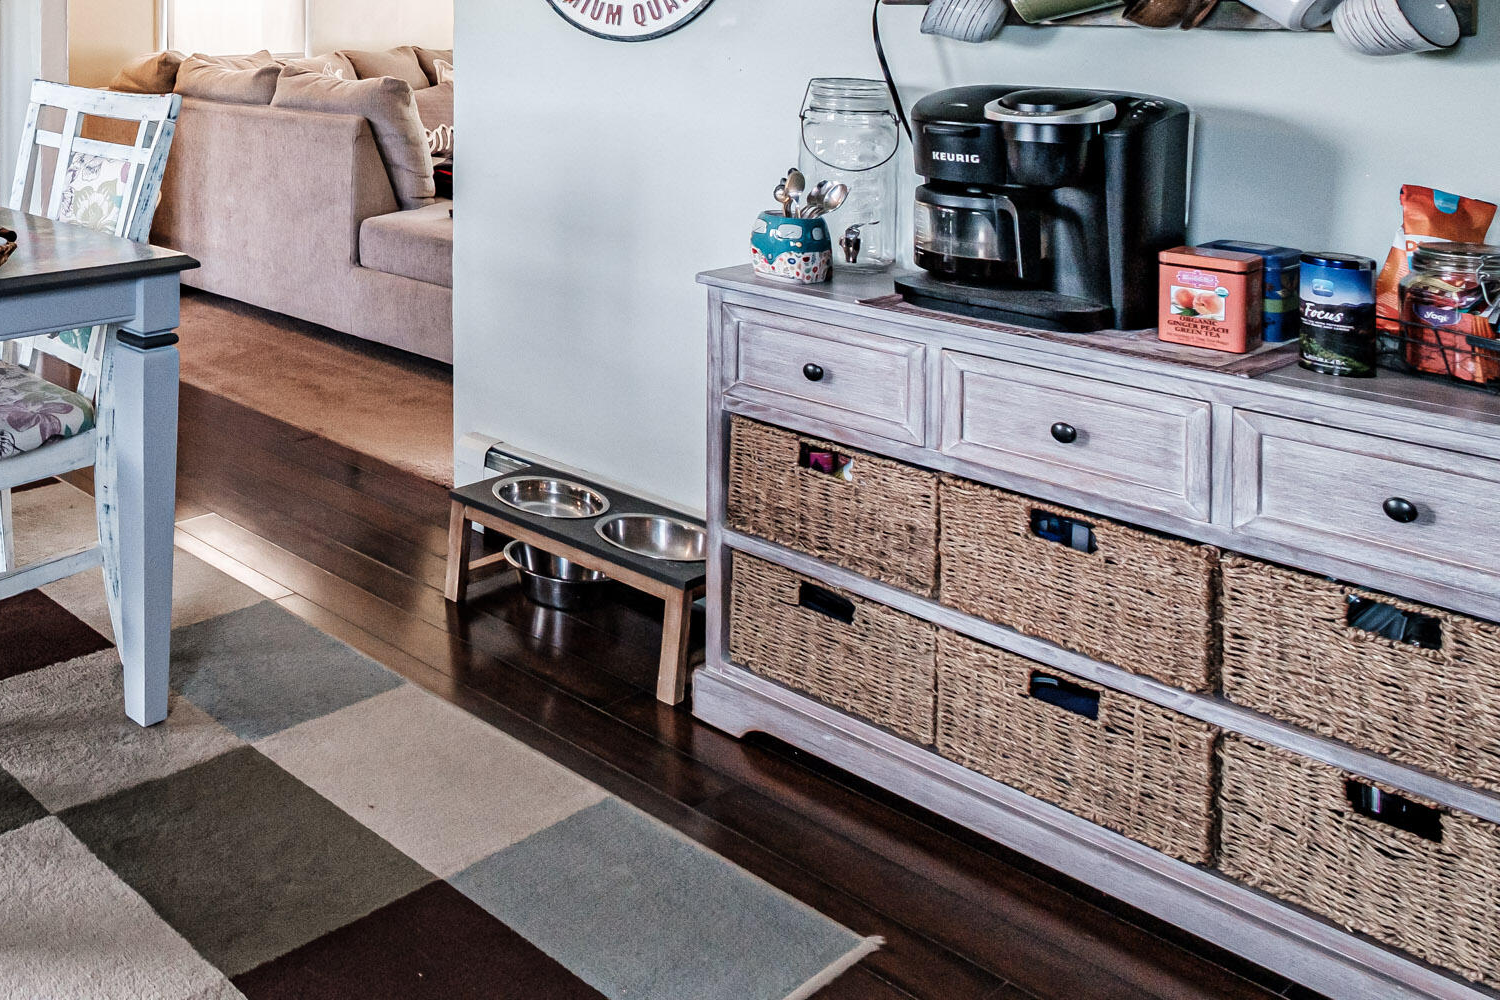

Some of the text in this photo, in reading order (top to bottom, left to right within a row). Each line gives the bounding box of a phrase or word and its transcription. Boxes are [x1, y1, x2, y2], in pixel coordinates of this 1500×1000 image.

[932, 151, 980, 164] KEURIG
[1304, 302, 1344, 323] Focus
[1167, 319, 1229, 334] GINGER PEACH
[1179, 315, 1219, 327] ORGANIC
[1174, 326, 1201, 336] GREEN
[1204, 330, 1221, 339] TEA
